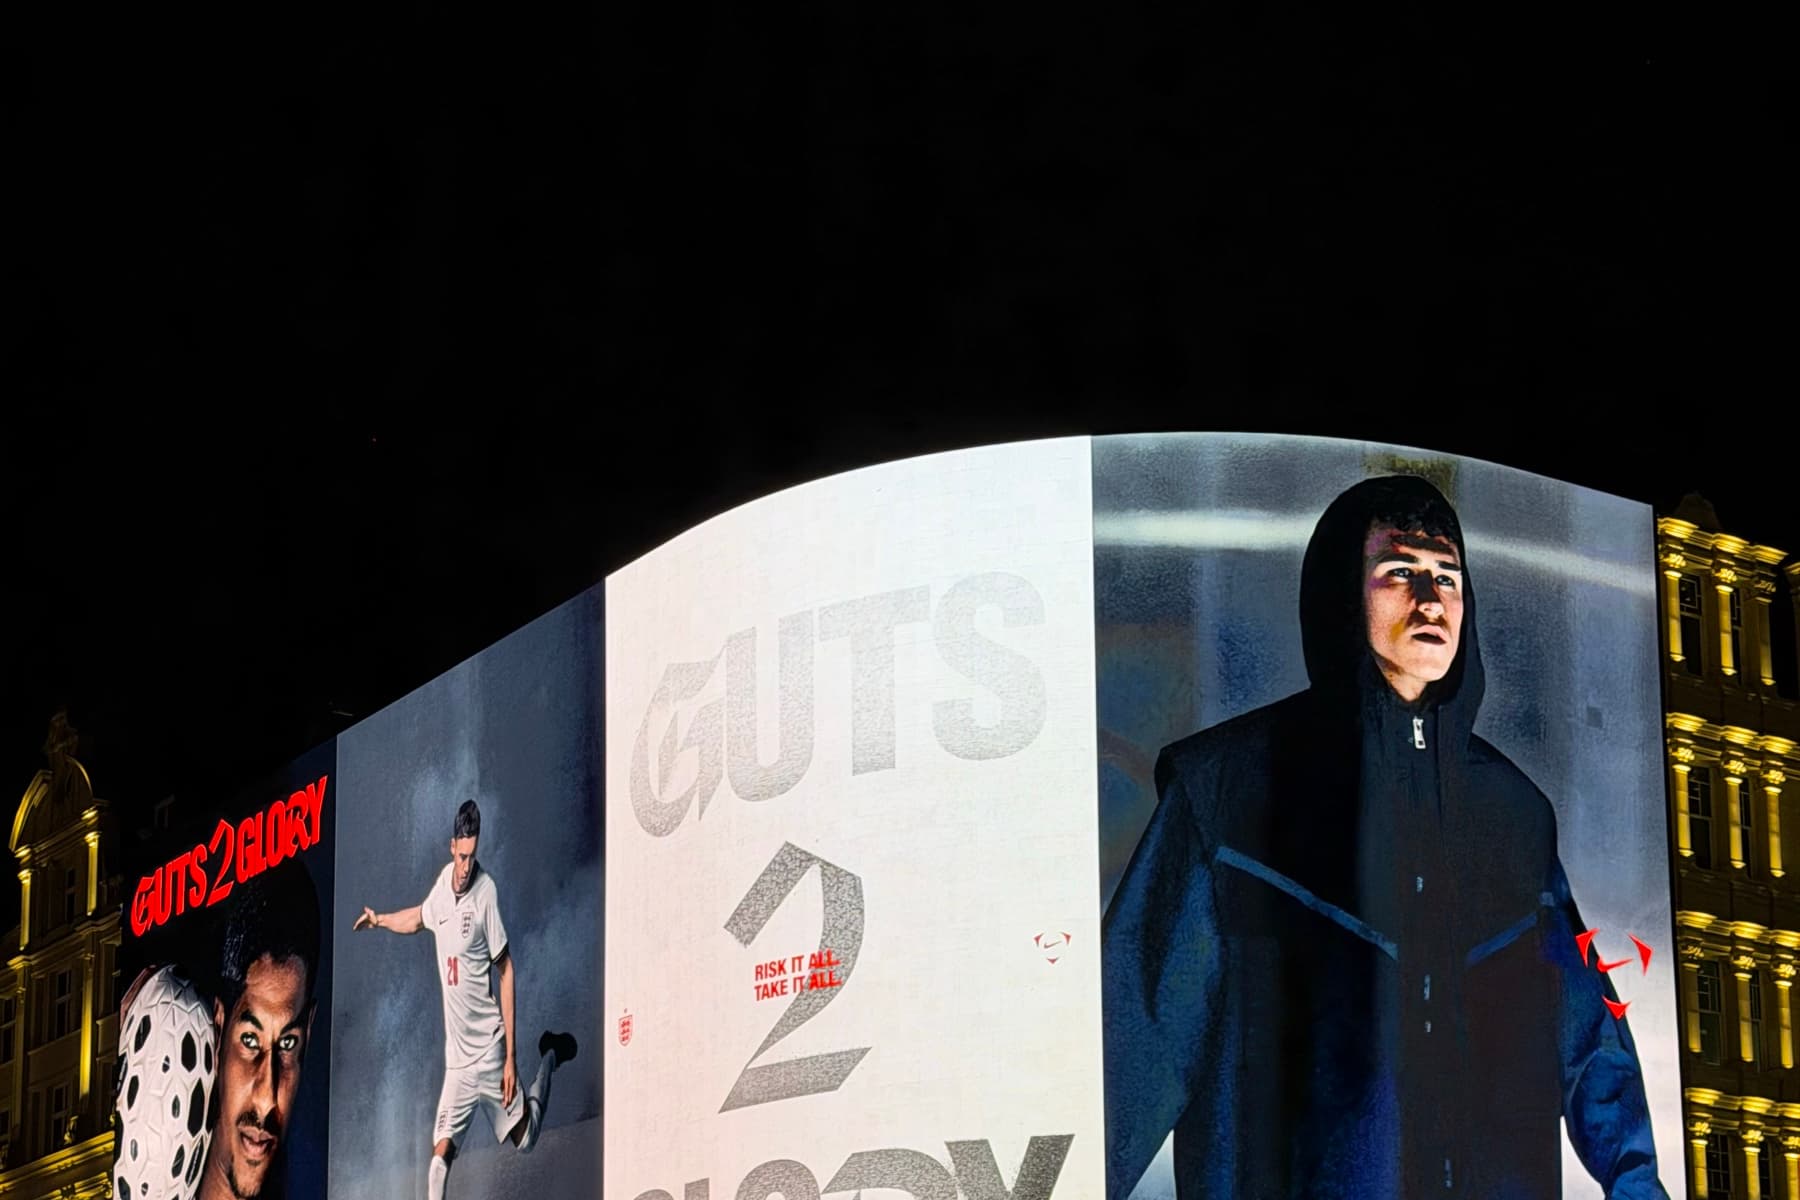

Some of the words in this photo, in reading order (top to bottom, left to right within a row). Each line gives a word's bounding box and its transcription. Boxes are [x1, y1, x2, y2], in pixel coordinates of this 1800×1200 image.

[629, 570, 1047, 838] GUTS
[718, 841, 873, 1114] 2
[754, 979, 788, 1001] TAKE
[793, 975, 805, 993] IT
[755, 958, 787, 981] RISK
[792, 955, 804, 973] IT
